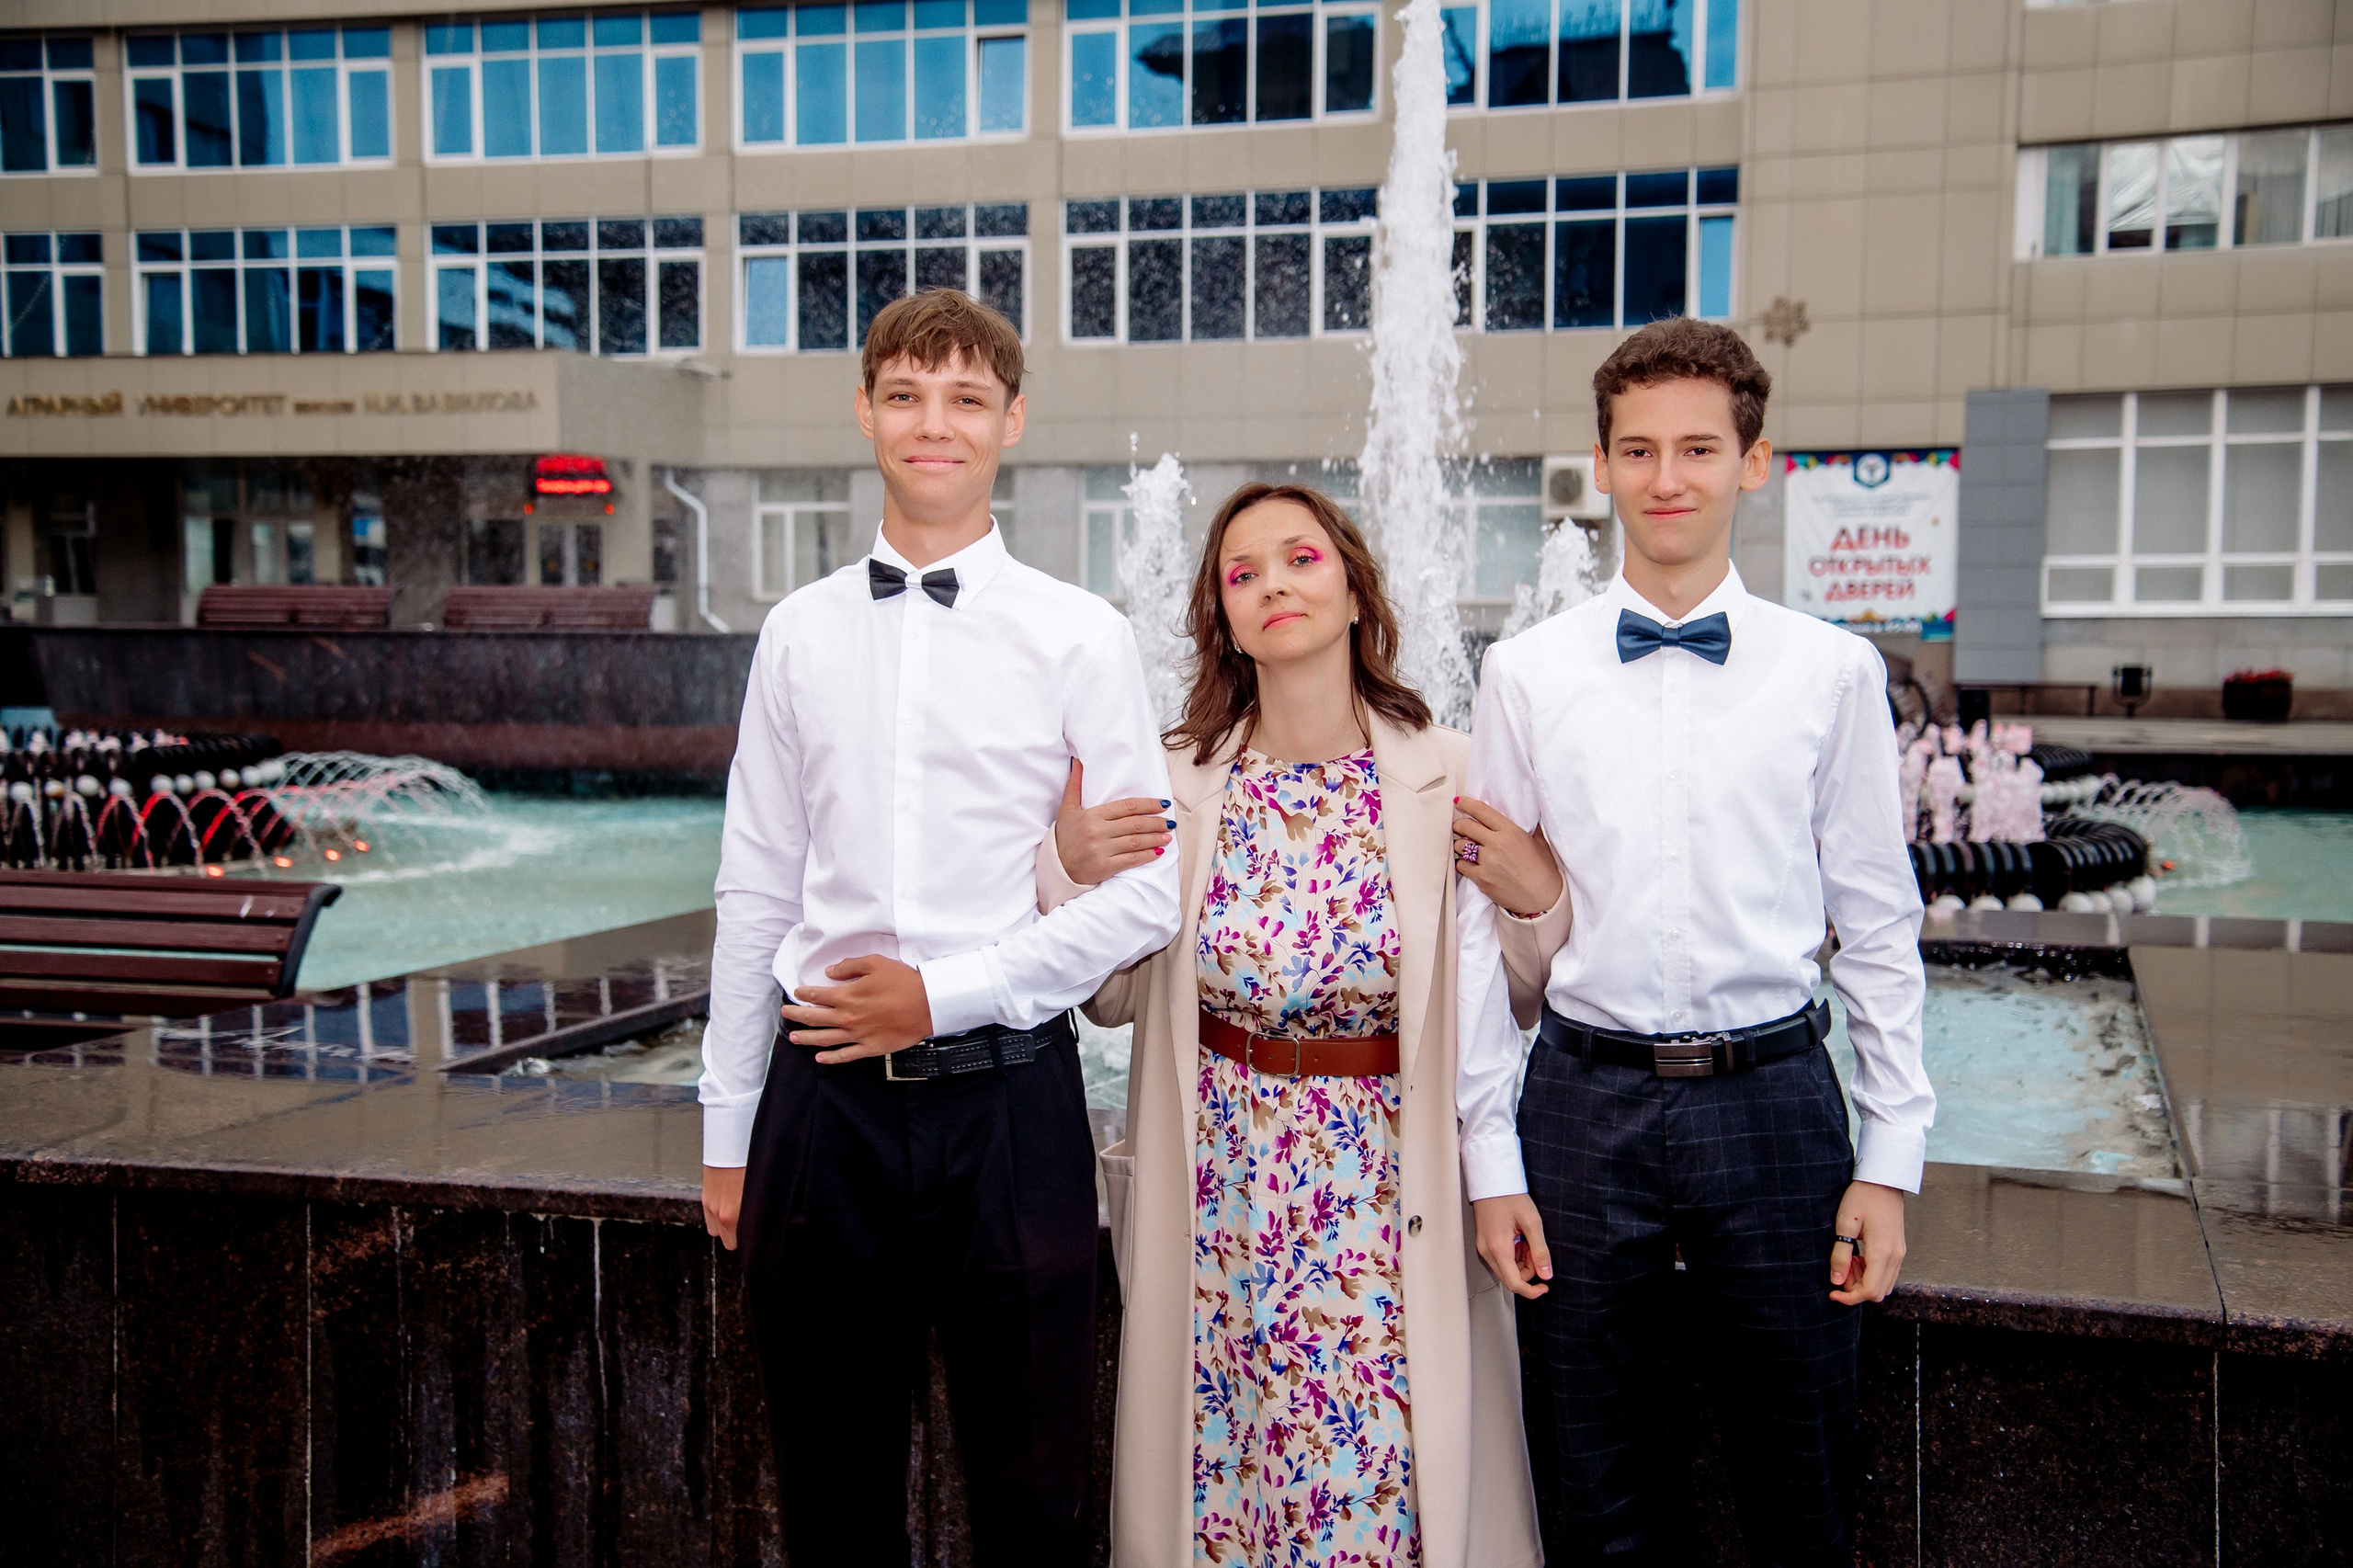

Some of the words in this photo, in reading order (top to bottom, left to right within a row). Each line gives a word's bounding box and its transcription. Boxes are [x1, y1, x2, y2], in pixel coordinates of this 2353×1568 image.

[1830, 525, 1910, 552] ДЕНЬ
[1808, 555, 1932, 577] ОТКРЫТЫХ
[1824, 578, 1915, 602] ДВЕРЕЙ
